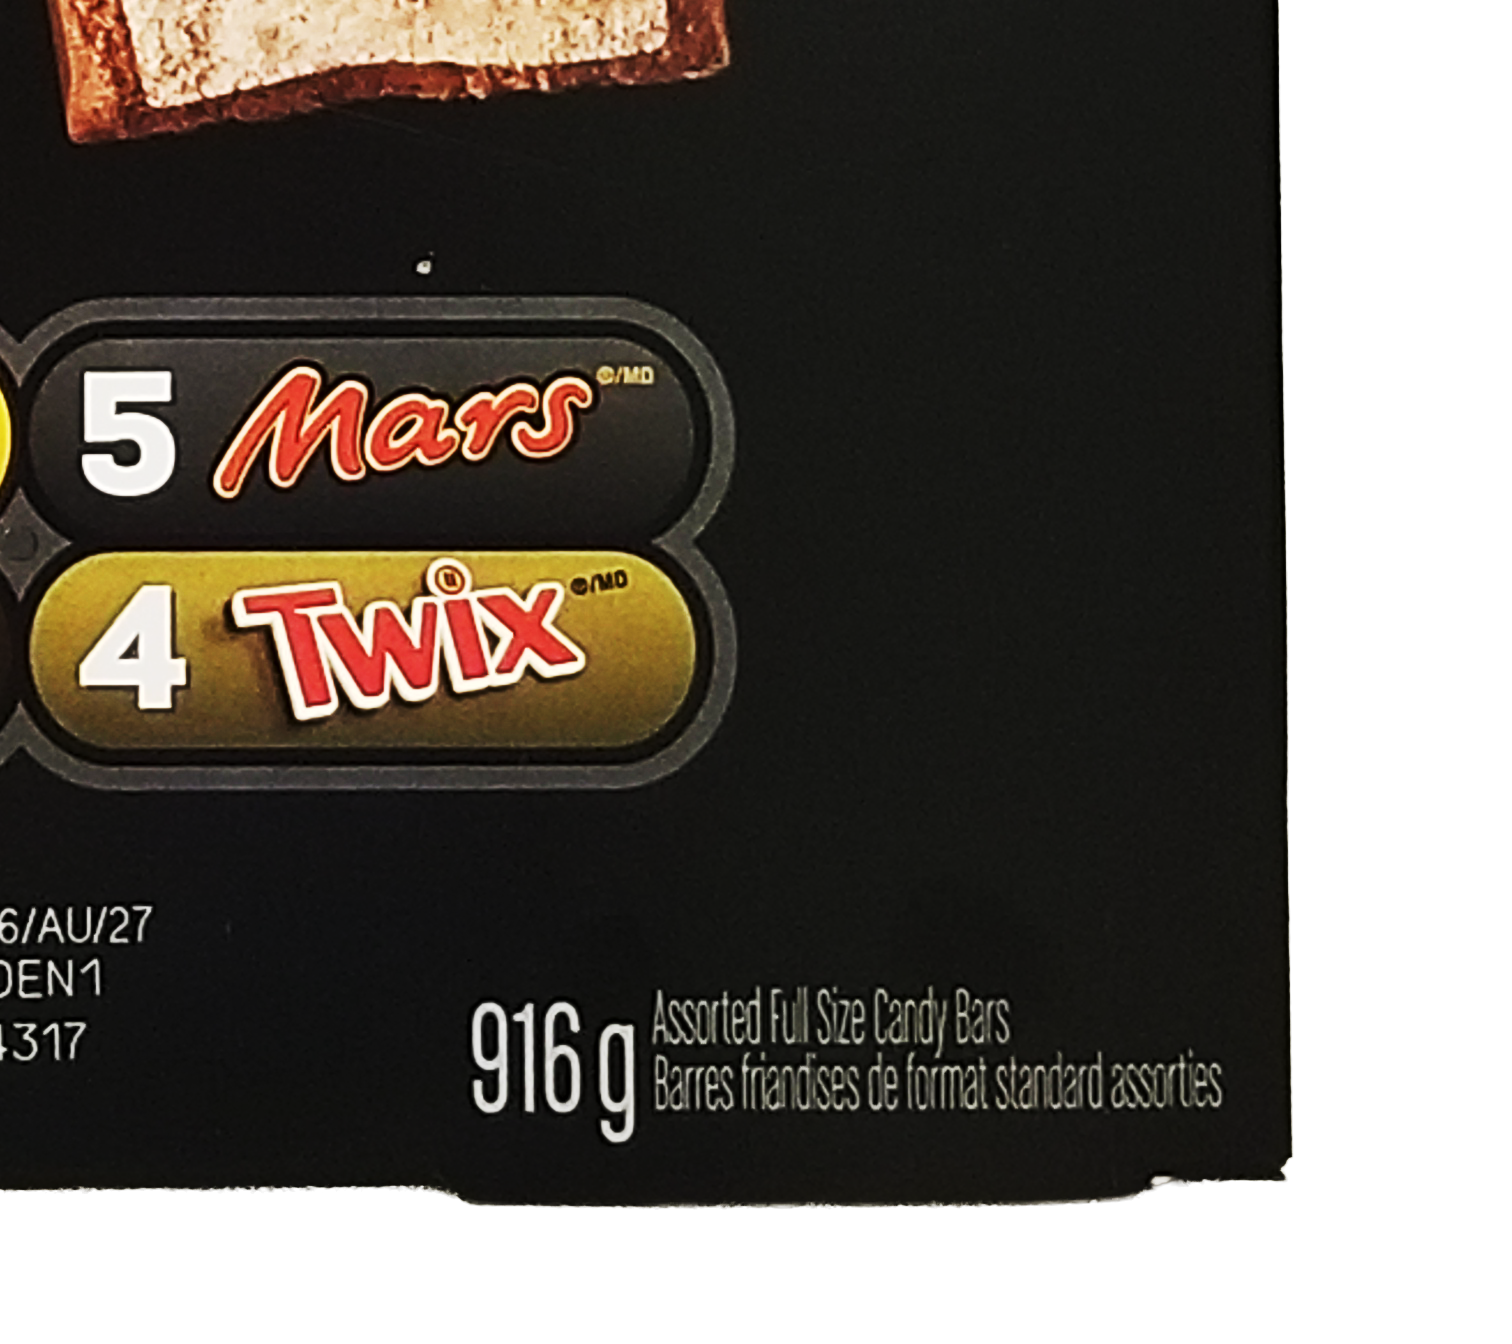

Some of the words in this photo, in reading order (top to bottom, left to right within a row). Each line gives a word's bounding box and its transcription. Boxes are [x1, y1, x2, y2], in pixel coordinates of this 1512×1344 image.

[80, 370, 177, 497] 5
[213, 366, 594, 499] Mars
[79, 584, 187, 711] 4
[471, 1001, 582, 1114] 916
[599, 1022, 636, 1144] g
[652, 985, 761, 1045] Assorted
[771, 986, 808, 1044] Full
[816, 986, 865, 1045] Size
[873, 985, 947, 1059] Candy
[955, 987, 1011, 1045] Bars
[654, 1053, 735, 1111] Barres
[741, 1051, 860, 1111] friandises
[868, 1051, 899, 1111] de
[906, 1051, 989, 1111] format
[995, 1050, 1103, 1110] standard
[1110, 1047, 1223, 1109] assorties
